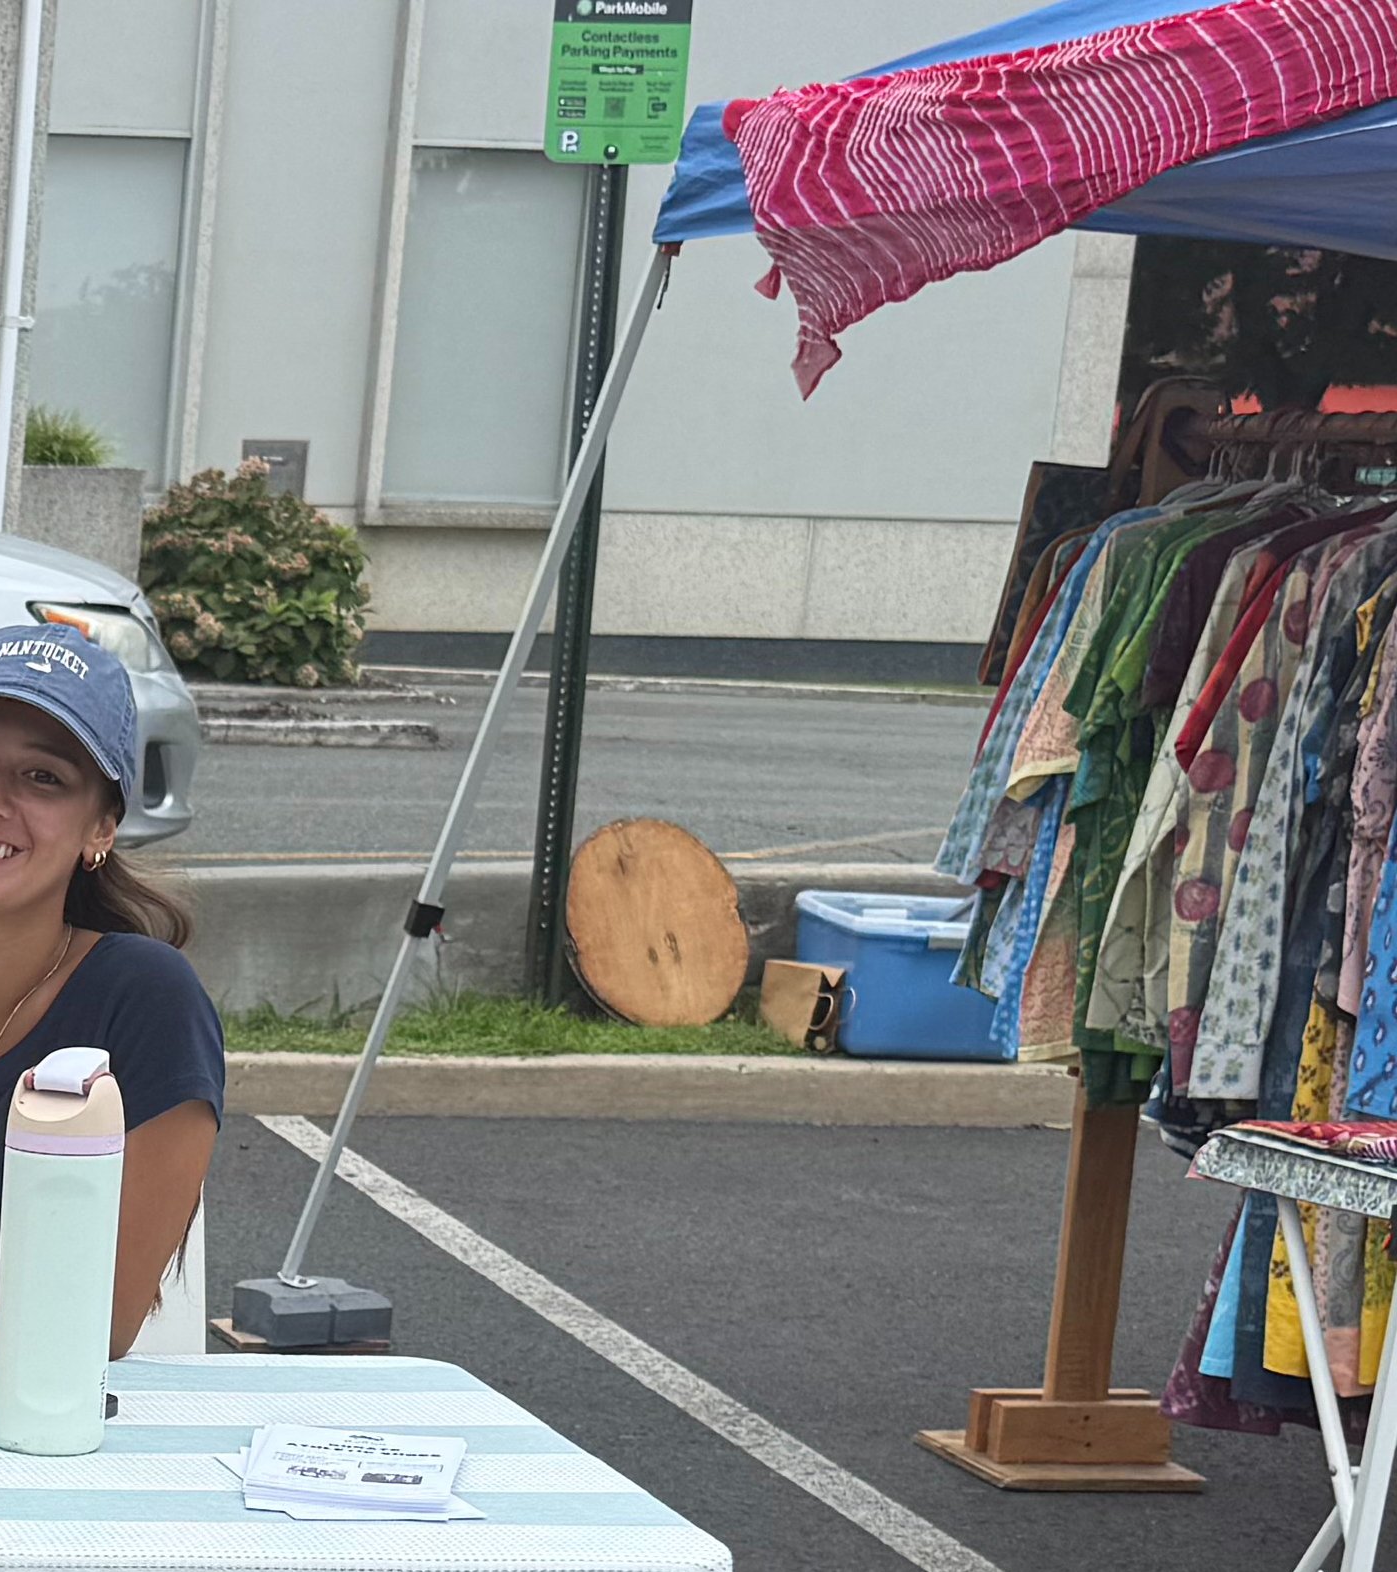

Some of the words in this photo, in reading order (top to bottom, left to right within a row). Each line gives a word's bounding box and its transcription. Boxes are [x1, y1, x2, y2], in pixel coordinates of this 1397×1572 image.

[595, 1, 668, 15] ParkMobile
[581, 30, 660, 44] Contactless
[561, 44, 610, 60] Parking
[612, 45, 678, 60] Payments
